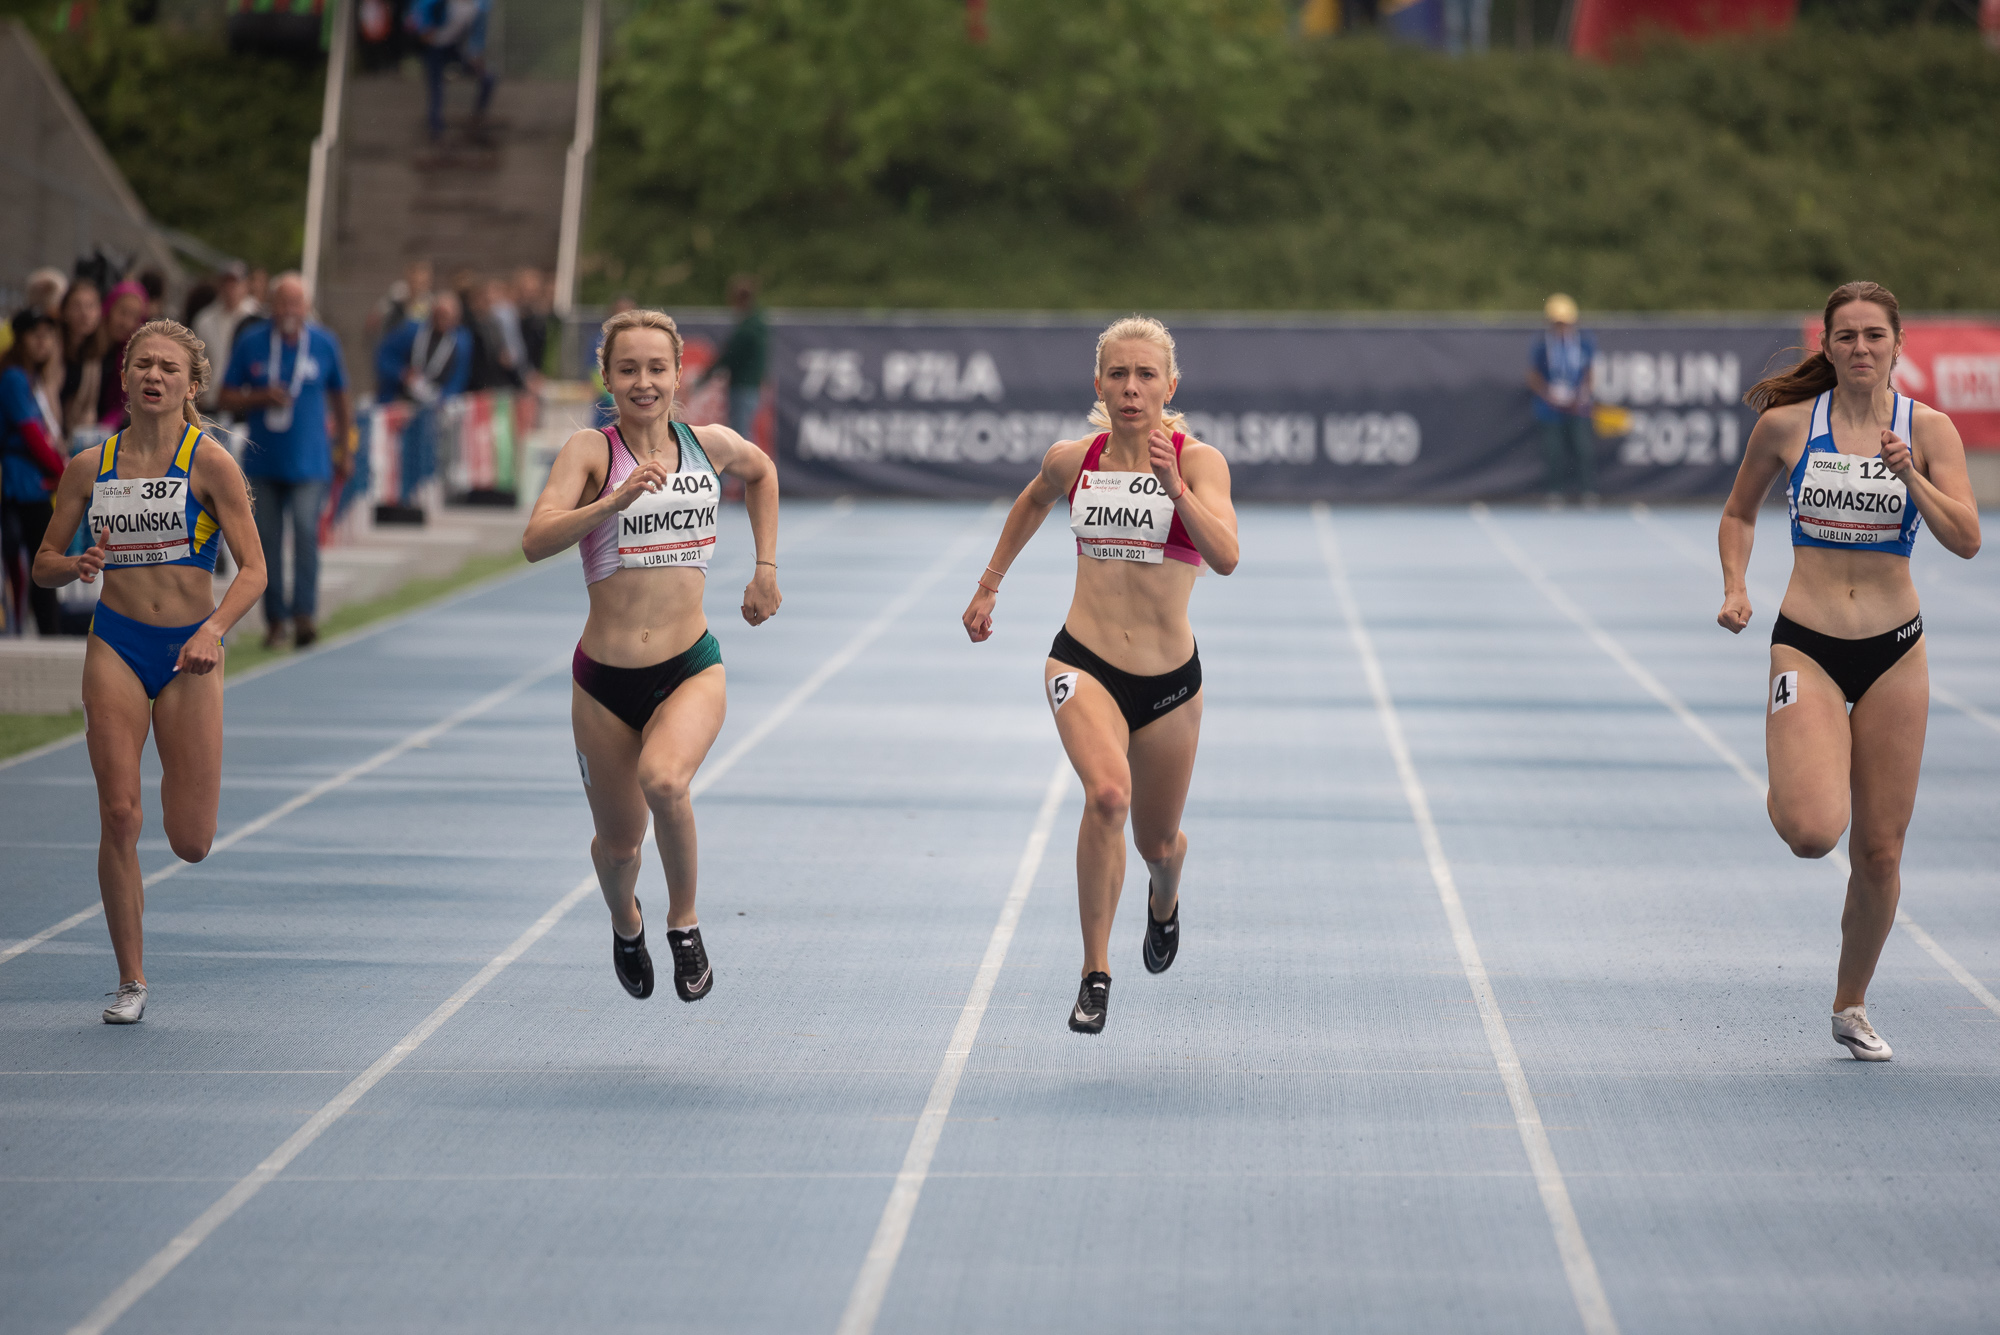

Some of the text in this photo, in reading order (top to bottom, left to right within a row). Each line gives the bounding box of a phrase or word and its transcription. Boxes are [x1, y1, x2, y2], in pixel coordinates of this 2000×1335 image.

[881, 350, 1003, 401] PZLA
[1594, 350, 1741, 404] UBLIN
[797, 410, 1421, 465] MISTRZOSTW OLSKI U20
[140, 481, 183, 500] 387
[671, 474, 713, 495] 404
[1802, 487, 1902, 514] ROMASZKO
[92, 508, 183, 534] ZWOLIŃSKA
[623, 505, 716, 536] NIEMCZYK
[1083, 506, 1154, 530] ZIMNA
[1818, 528, 1878, 542] LUBLIN 2021
[113, 550, 168, 563] LUBLIN 2021
[643, 549, 701, 565] LUBLIN 2021
[1093, 547, 1145, 560] LUBLIN 2021
[1897, 620, 1921, 642] NIKE
[1054, 674, 1069, 705] 5
[1775, 675, 1791, 705] 4
